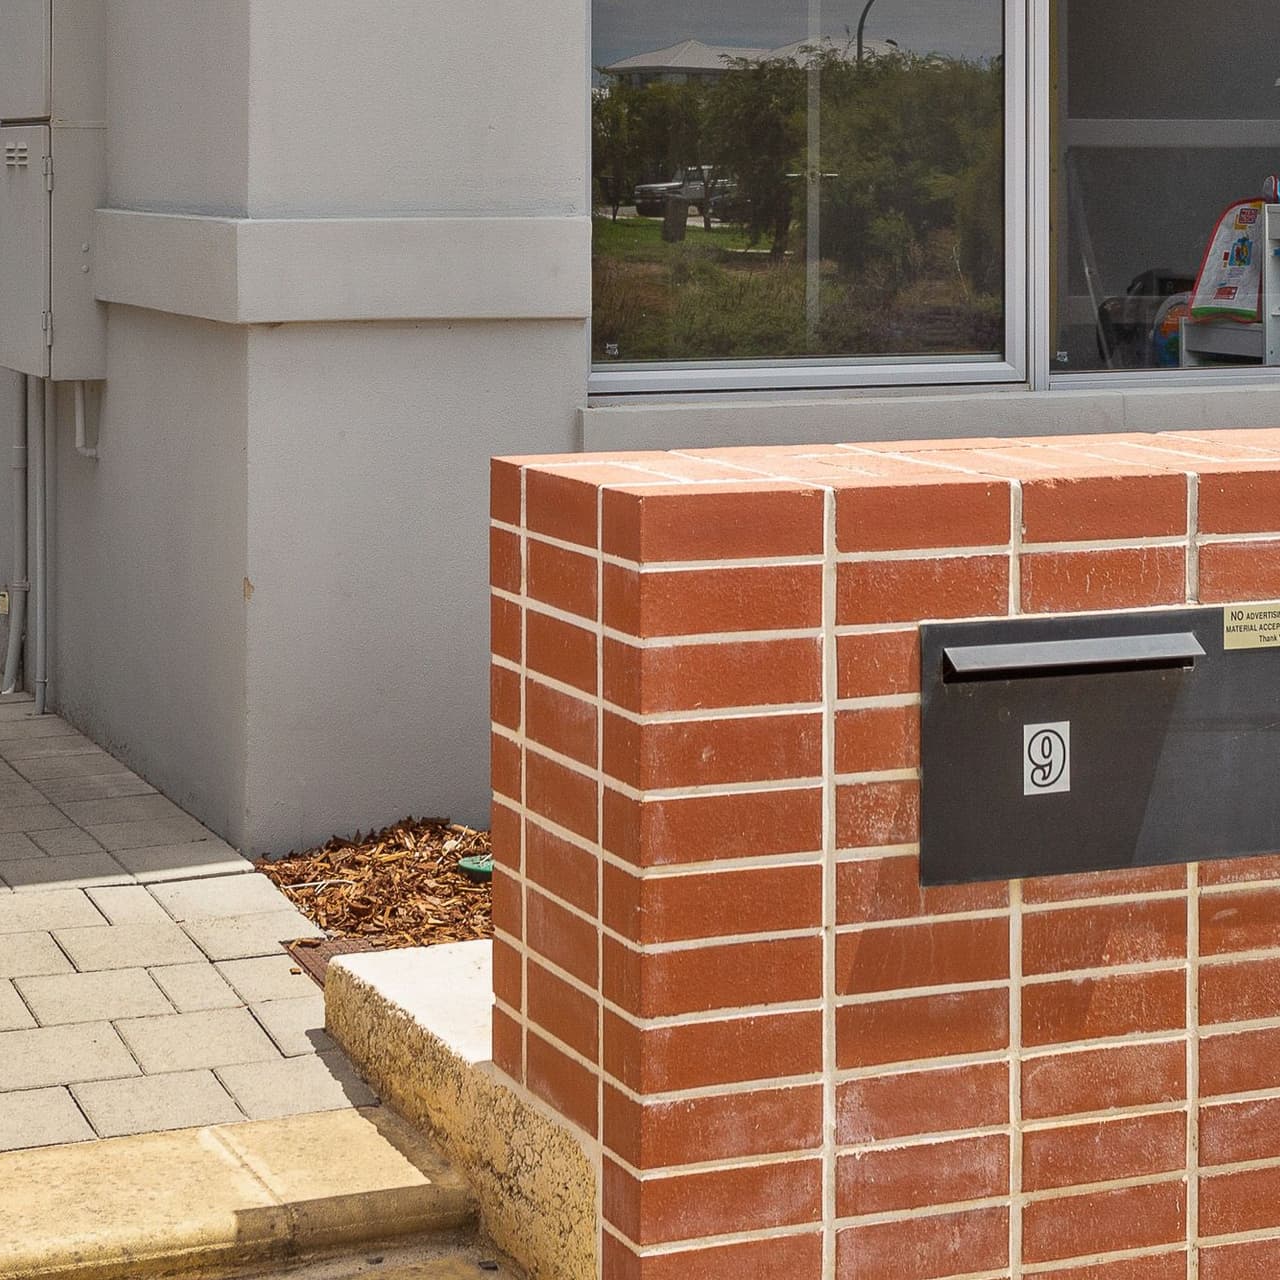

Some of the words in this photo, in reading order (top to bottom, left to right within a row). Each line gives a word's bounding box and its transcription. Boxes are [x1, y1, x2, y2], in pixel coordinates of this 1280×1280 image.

[1230, 610, 1244, 621] NO
[1225, 623, 1258, 633] MATERIAL
[1259, 634, 1277, 642] Thank
[1027, 728, 1067, 788] 9
